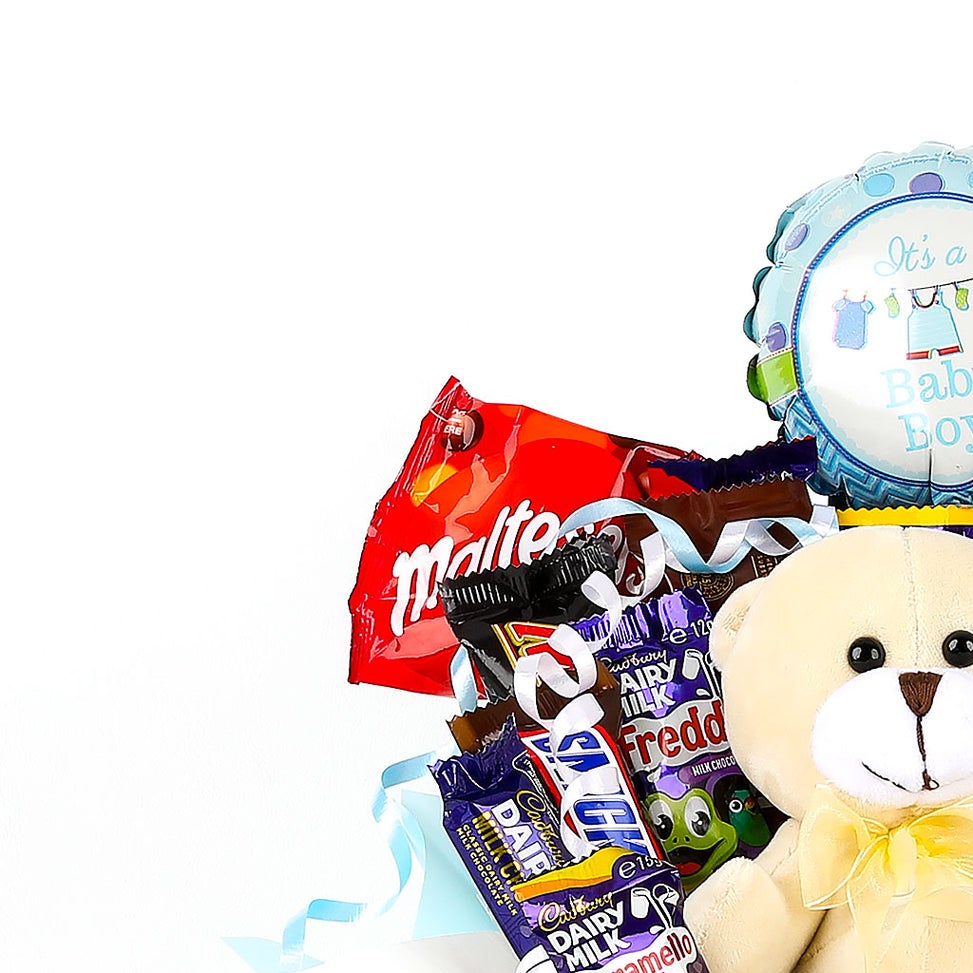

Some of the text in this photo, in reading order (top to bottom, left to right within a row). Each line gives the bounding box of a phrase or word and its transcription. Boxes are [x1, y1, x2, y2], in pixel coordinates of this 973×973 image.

[873, 235, 967, 276] It's a
[619, 658, 677, 694] AIRY
[456, 827, 505, 907] MILK CHOCOLATE
[462, 824, 518, 916] CLASSIC DAIRY MILK
[538, 892, 614, 932] Cadbury
[547, 901, 624, 954] DAIRY
[564, 929, 632, 972] MILK
